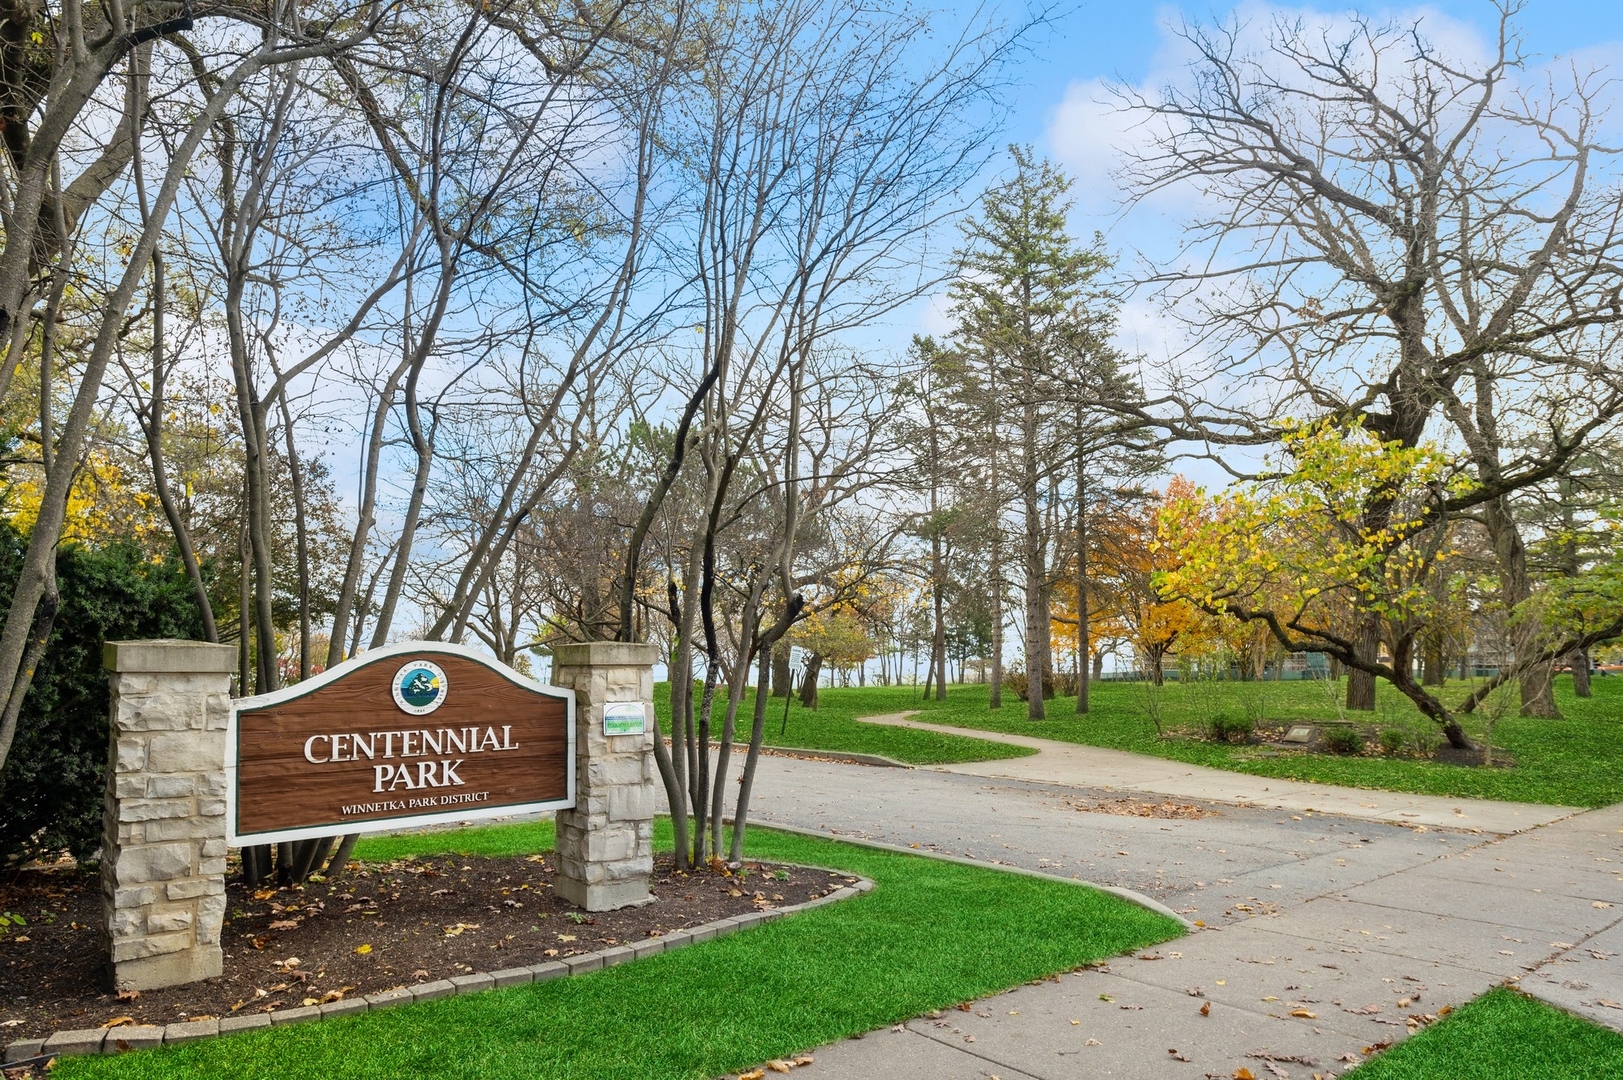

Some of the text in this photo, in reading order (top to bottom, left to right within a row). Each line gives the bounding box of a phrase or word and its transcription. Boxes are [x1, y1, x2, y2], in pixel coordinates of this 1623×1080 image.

[304, 725, 519, 763] CENTENNIAL
[373, 759, 465, 792] PARK
[342, 791, 490, 814] WINNETKA PARK DISTRICT
